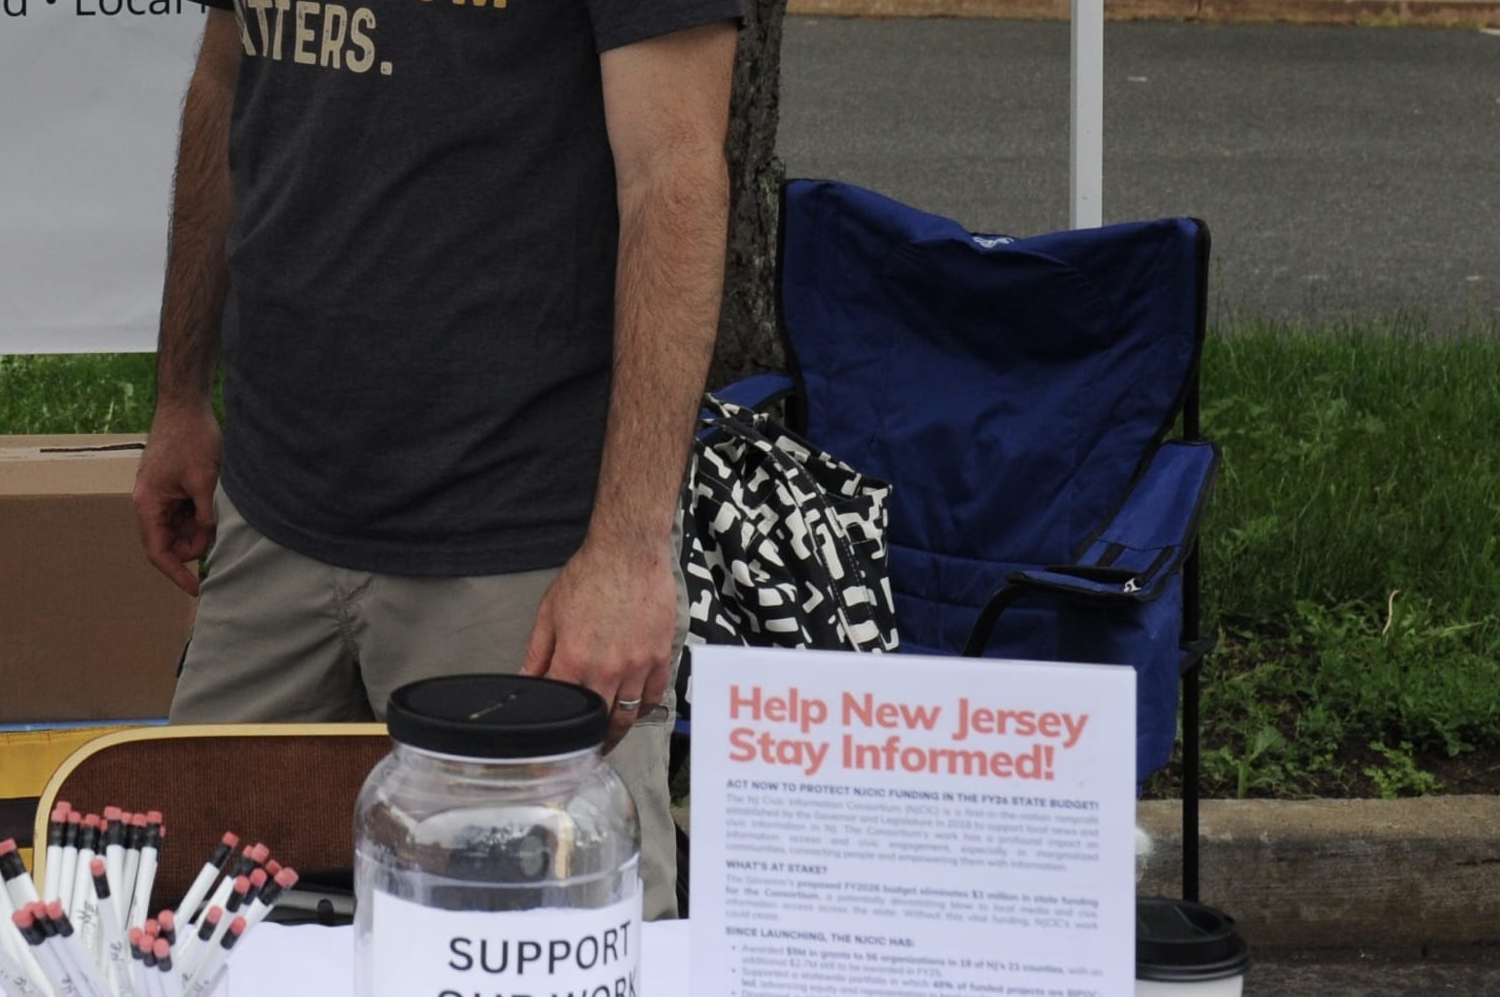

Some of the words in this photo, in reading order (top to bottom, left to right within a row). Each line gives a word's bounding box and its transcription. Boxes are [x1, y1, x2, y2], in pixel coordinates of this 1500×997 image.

[729, 685, 828, 733] Help
[842, 692, 942, 731] New
[952, 698, 1089, 749] Jersey
[728, 727, 830, 777] Stay
[842, 733, 1055, 781] Informed!
[726, 779, 748, 789] ACT
[751, 780, 778, 790] NOW
[782, 782, 796, 791] TO
[799, 783, 850, 795] PROTECT
[888, 788, 939, 800] FUNDING
[942, 791, 955, 801] IN
[958, 792, 978, 802] THE
[1011, 796, 1045, 806] STATE
[725, 860, 768, 871] WHAT'S
[770, 863, 785, 872] AT
[787, 864, 828, 875] STAKE?
[448, 920, 632, 975] SUPPORT
[831, 933, 852, 943] THE
